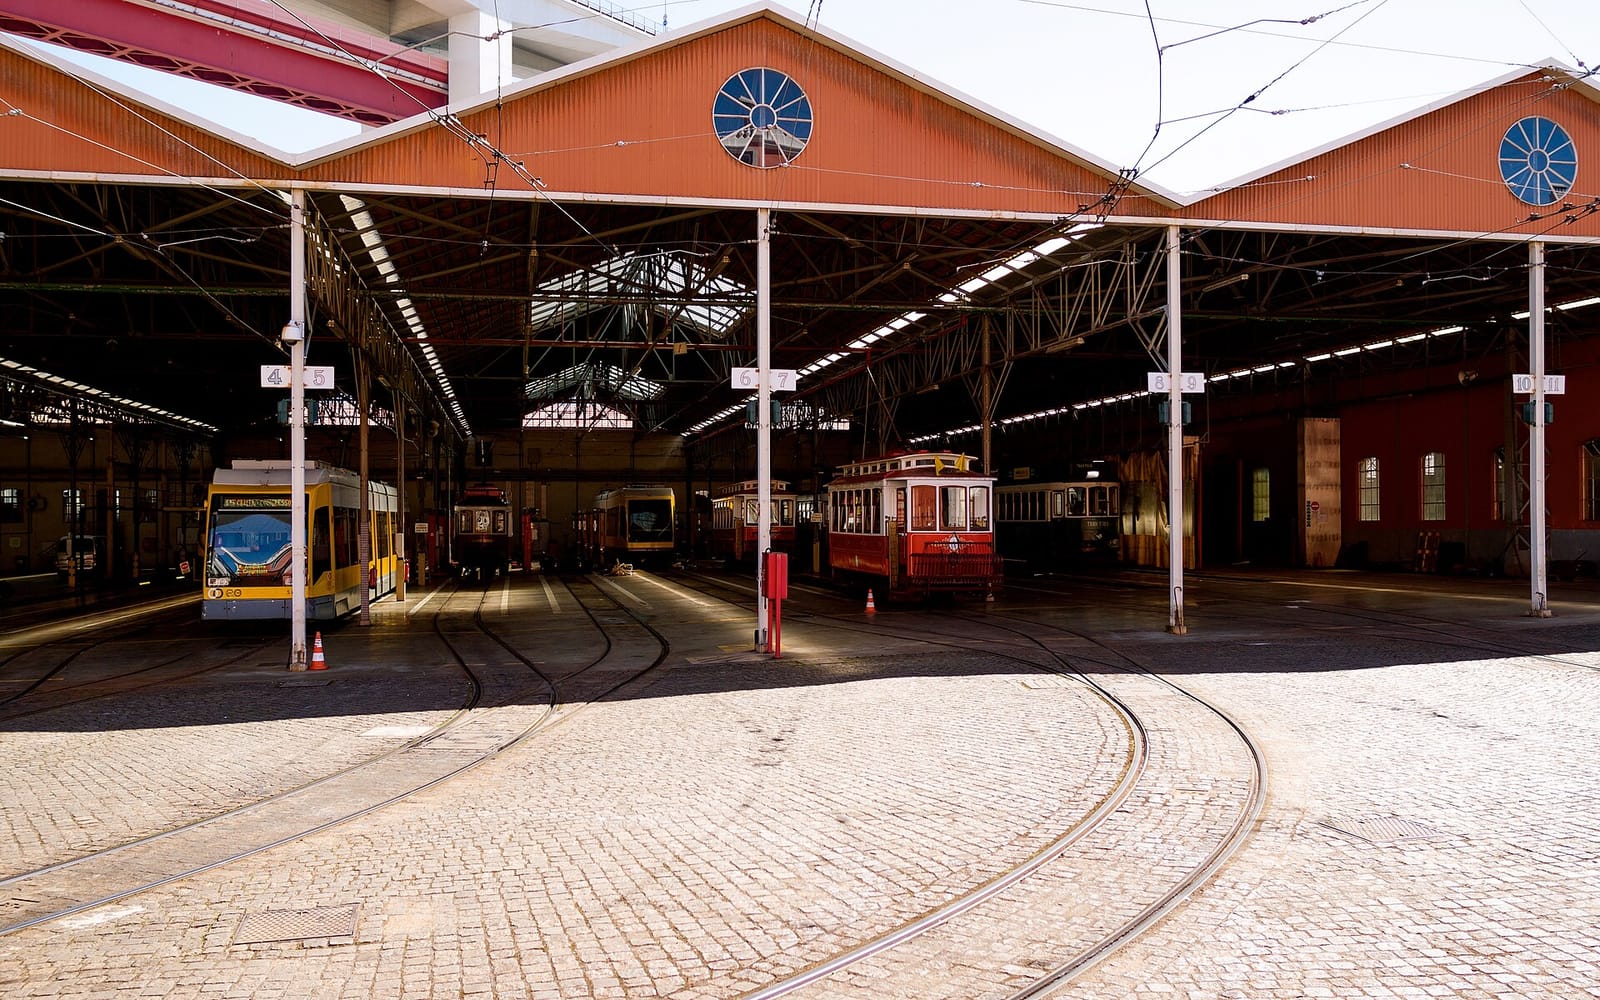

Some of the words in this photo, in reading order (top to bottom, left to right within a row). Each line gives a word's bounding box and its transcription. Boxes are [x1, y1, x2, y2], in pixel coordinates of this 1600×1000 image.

[268, 368, 282, 385] 4
[313, 369, 326, 386] 5
[739, 370, 751, 386] 6
[778, 372, 789, 388] 7
[1155, 375, 1165, 390] 8
[1187, 375, 1197, 390] 9
[1517, 376, 1532, 391] 10
[1547, 377, 1560, 392] 11
